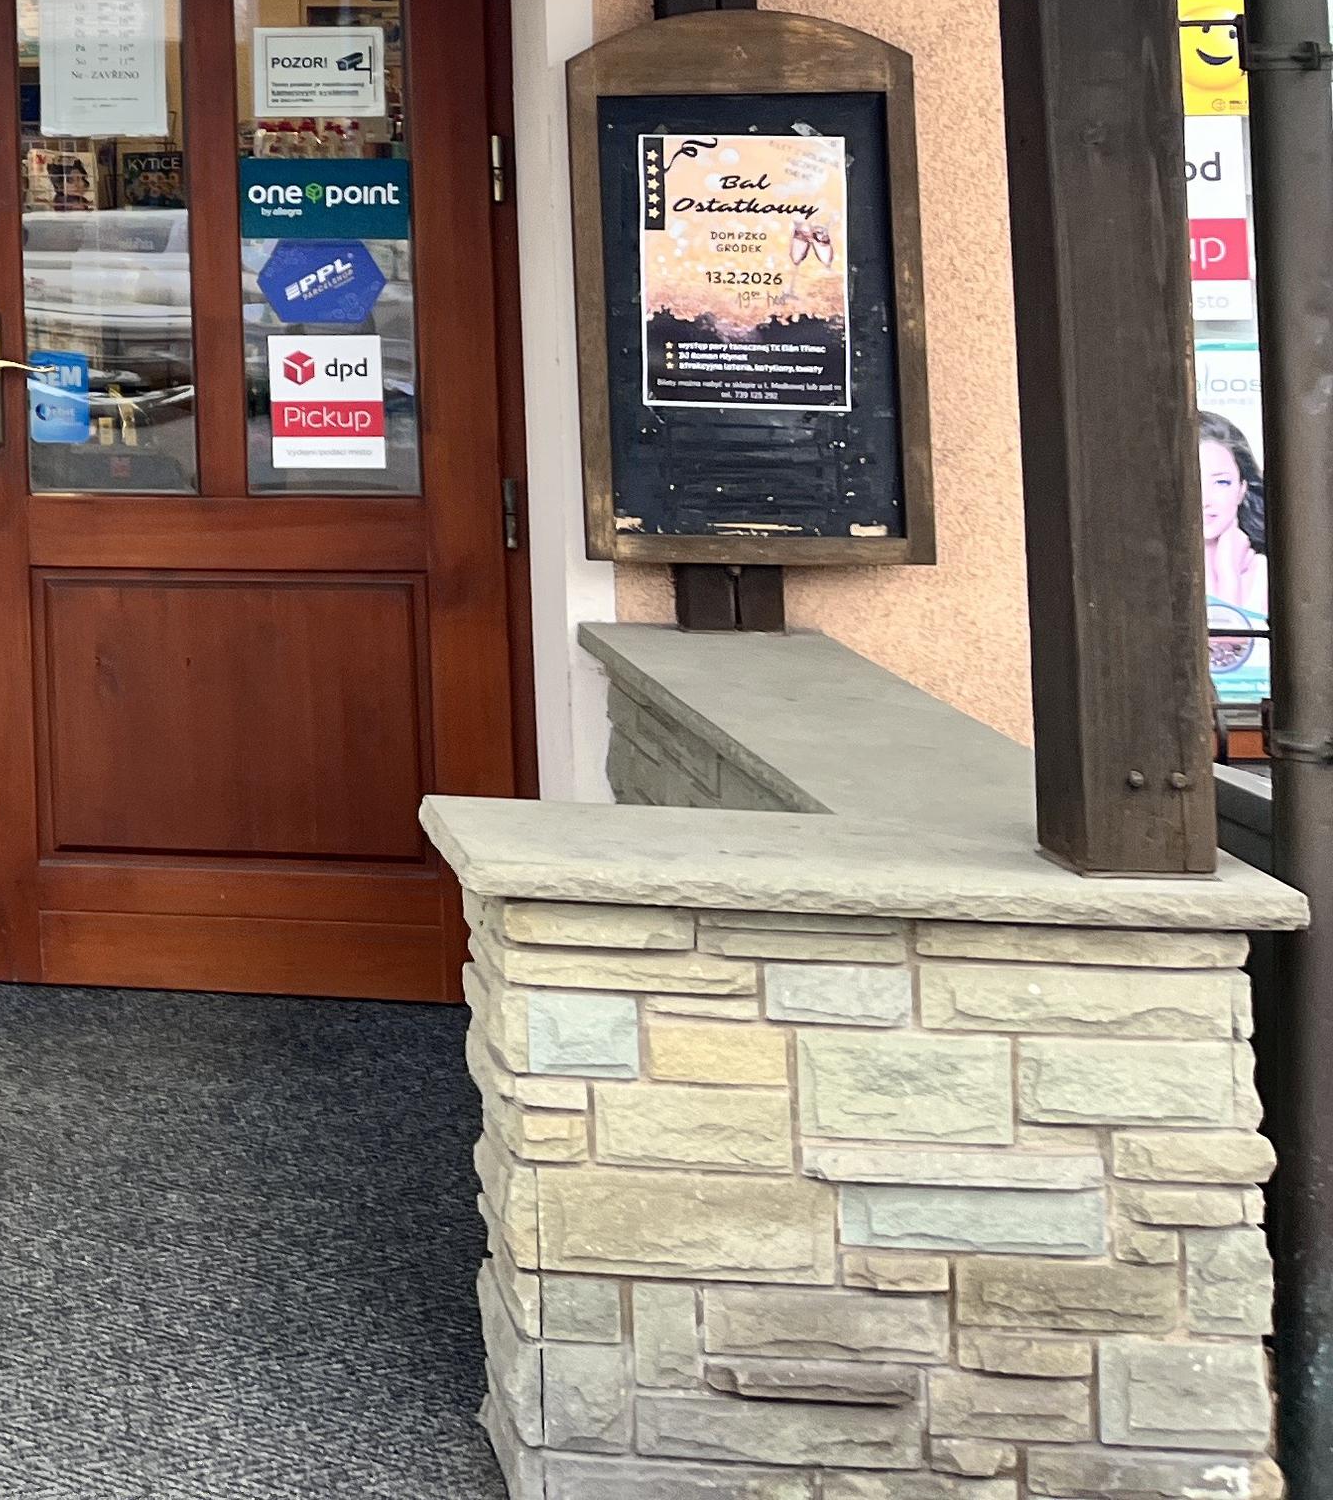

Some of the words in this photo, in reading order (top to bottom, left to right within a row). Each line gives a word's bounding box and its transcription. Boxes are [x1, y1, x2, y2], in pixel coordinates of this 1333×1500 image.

[271, 57, 328, 69] POZOR!
[91, 70, 140, 79] ZAVŘENO
[128, 158, 180, 170] KYTICE
[719, 174, 771, 190] Bal
[248, 185, 303, 204] one
[326, 183, 400, 207] point
[261, 207, 272, 216] by
[273, 207, 303, 218] allegro
[673, 197, 819, 219] Ostatkowy
[711, 231, 735, 240] DOM
[297, 258, 353, 293] PPL
[706, 272, 783, 285] 13.2.2026
[325, 358, 368, 382] dpd
[284, 407, 372, 432] Pickup
